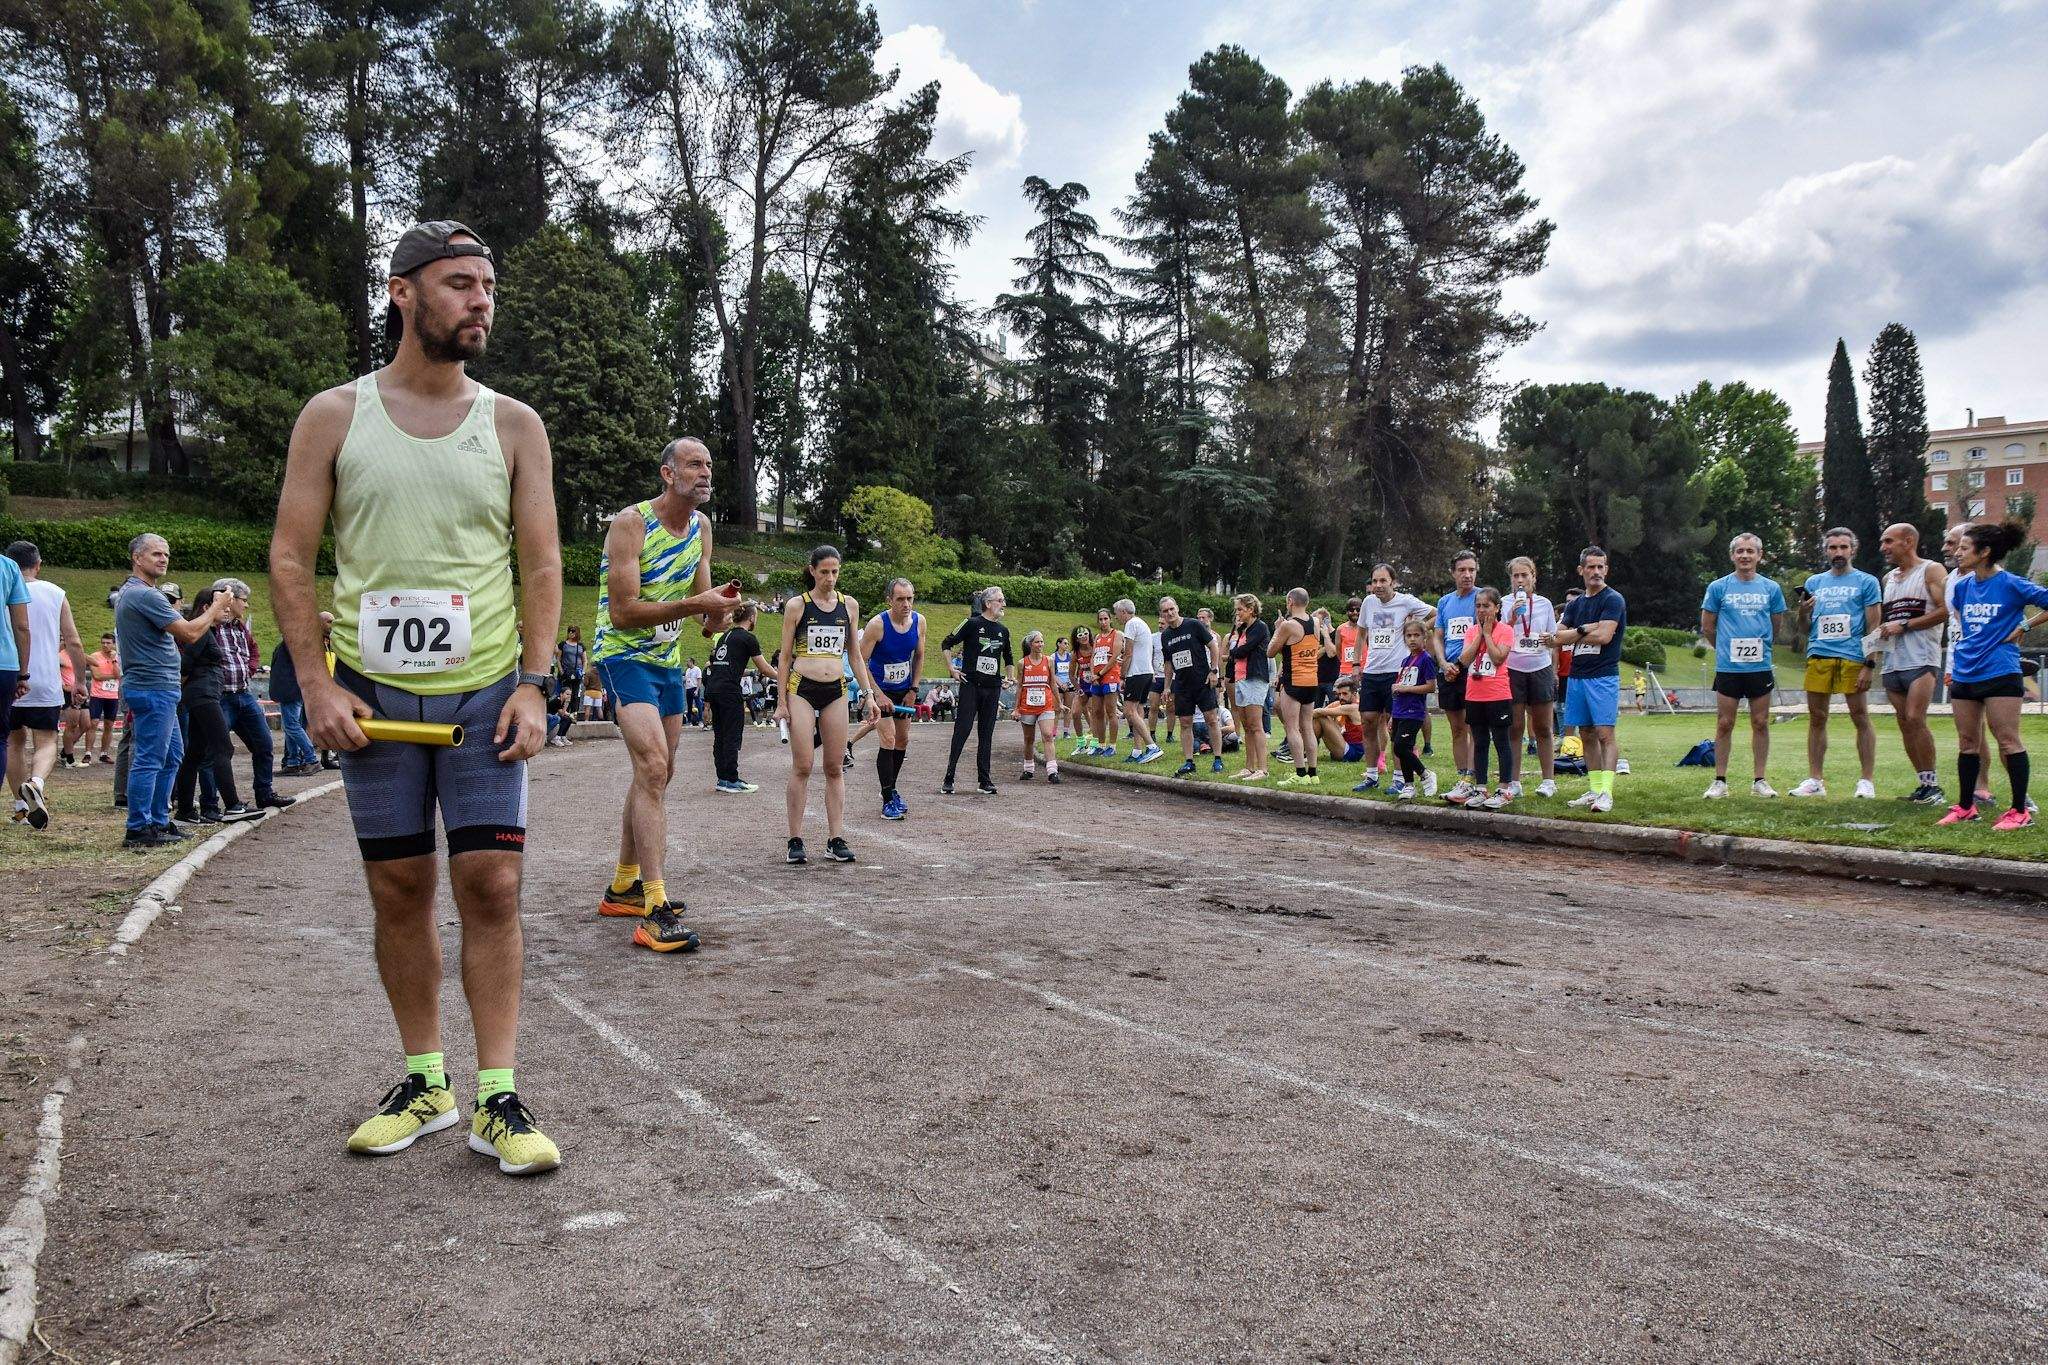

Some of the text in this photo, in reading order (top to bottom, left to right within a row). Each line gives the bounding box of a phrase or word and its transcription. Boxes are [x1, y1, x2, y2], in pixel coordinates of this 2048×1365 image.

[457, 444, 488, 454] adidas
[1815, 585, 1858, 598] SPORT
[1725, 593, 1770, 604] SPORT
[1451, 624, 1468, 634] 720
[1823, 622, 1844, 633] 883
[378, 617, 451, 653] 702
[1374, 635, 1390, 644] 828
[815, 636, 839, 648] 887
[1736, 646, 1757, 656] 722
[413, 656, 465, 667] rasán 2023
[1176, 656, 1188, 666] 708
[889, 670, 905, 680] 819
